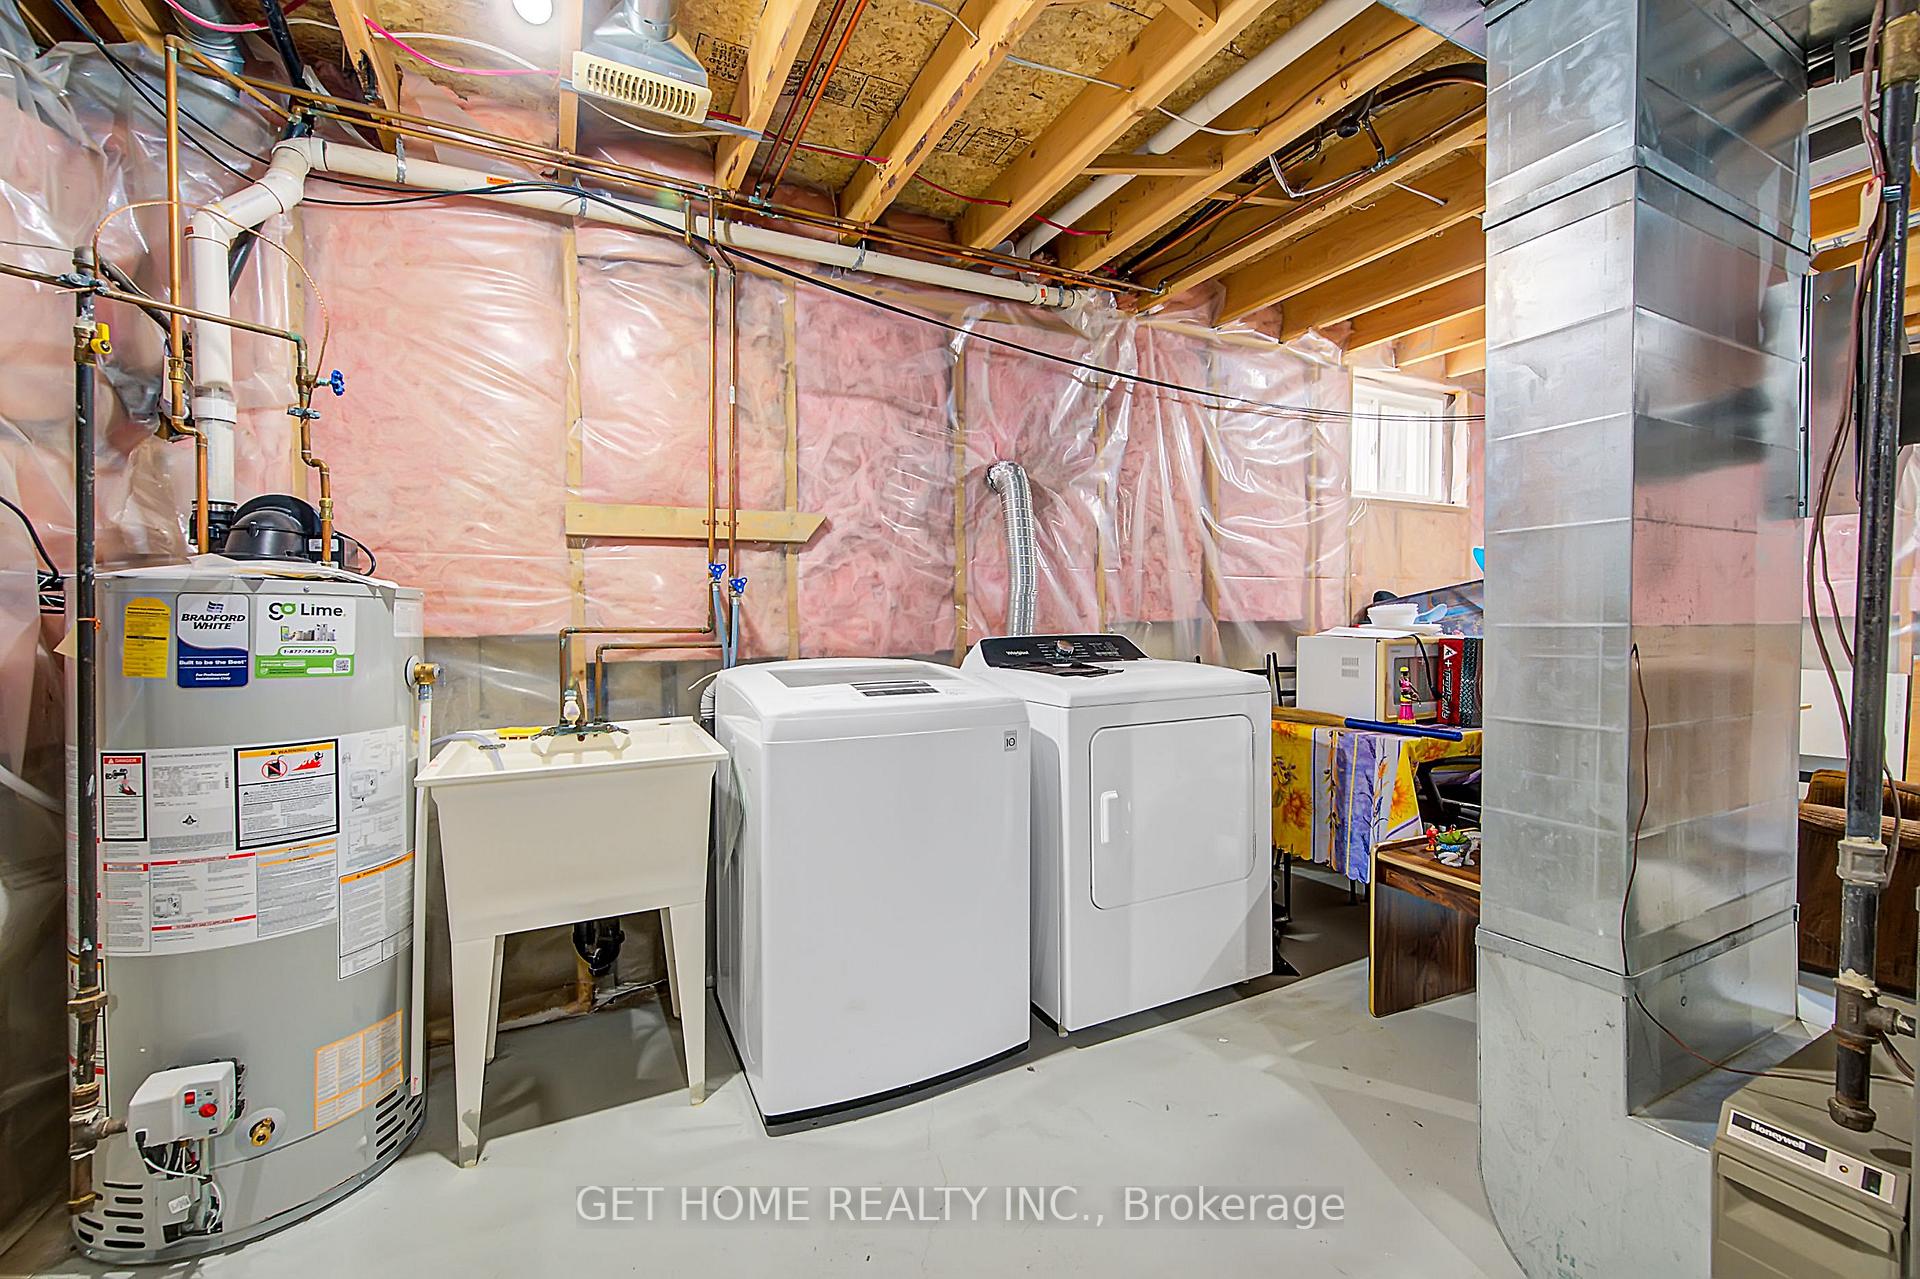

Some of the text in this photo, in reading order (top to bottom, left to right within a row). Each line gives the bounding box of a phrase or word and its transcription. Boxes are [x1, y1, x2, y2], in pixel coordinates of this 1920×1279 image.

[300, 603, 343, 617] Lime
[181, 613, 246, 622] BRADFORD
[193, 621, 232, 630] WHITE
[1750, 1122, 1806, 1150] Honeywell
